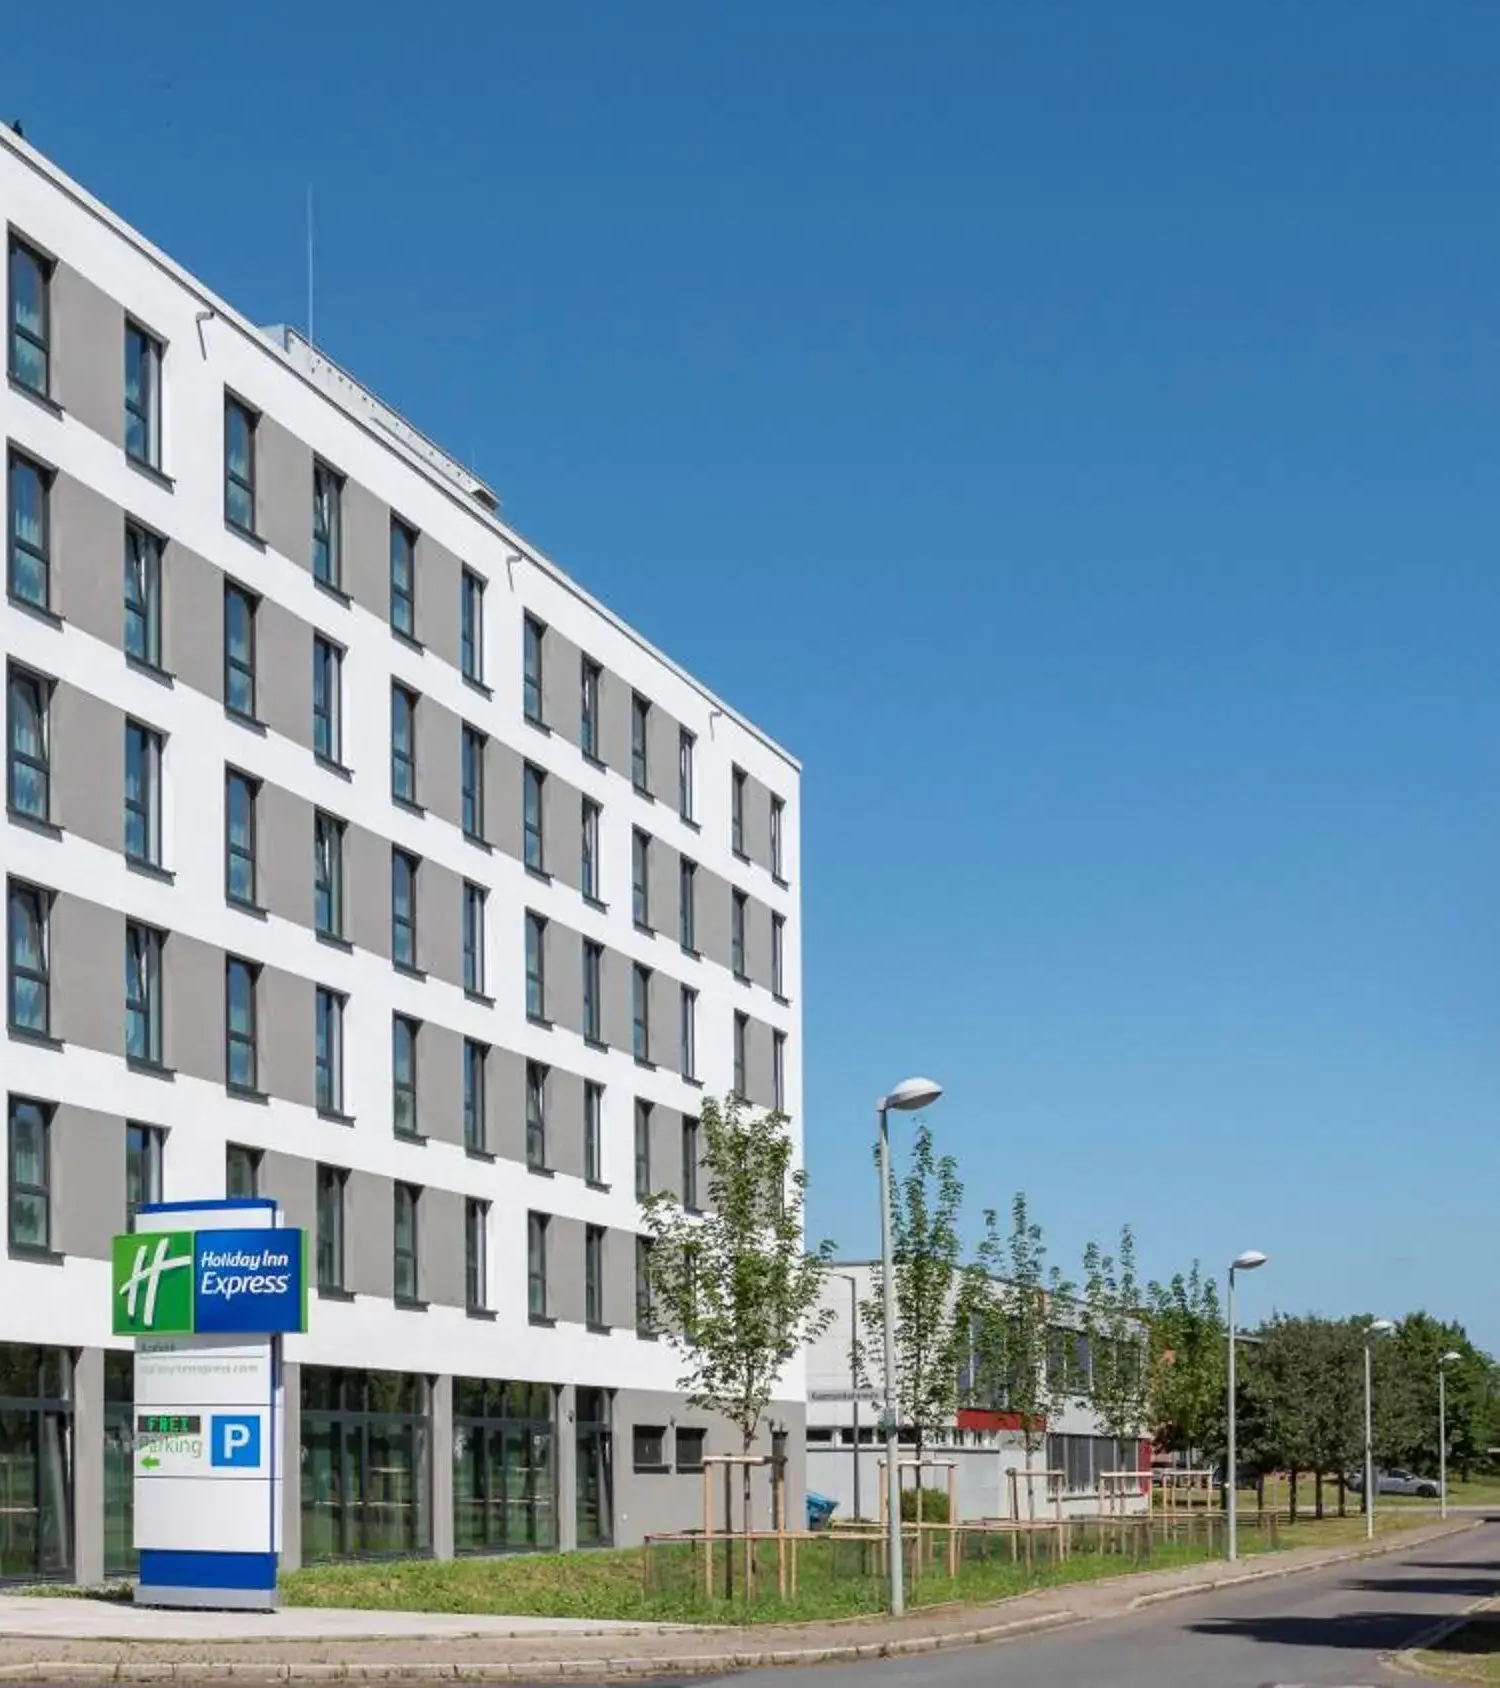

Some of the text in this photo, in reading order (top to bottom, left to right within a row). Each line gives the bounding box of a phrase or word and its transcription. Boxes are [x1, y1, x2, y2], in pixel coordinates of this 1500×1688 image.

[201, 1250, 289, 1271] Holiday Inn
[201, 1272, 290, 1300] Express
[139, 1436, 202, 1459] Parking
[223, 1423, 251, 1459] P
